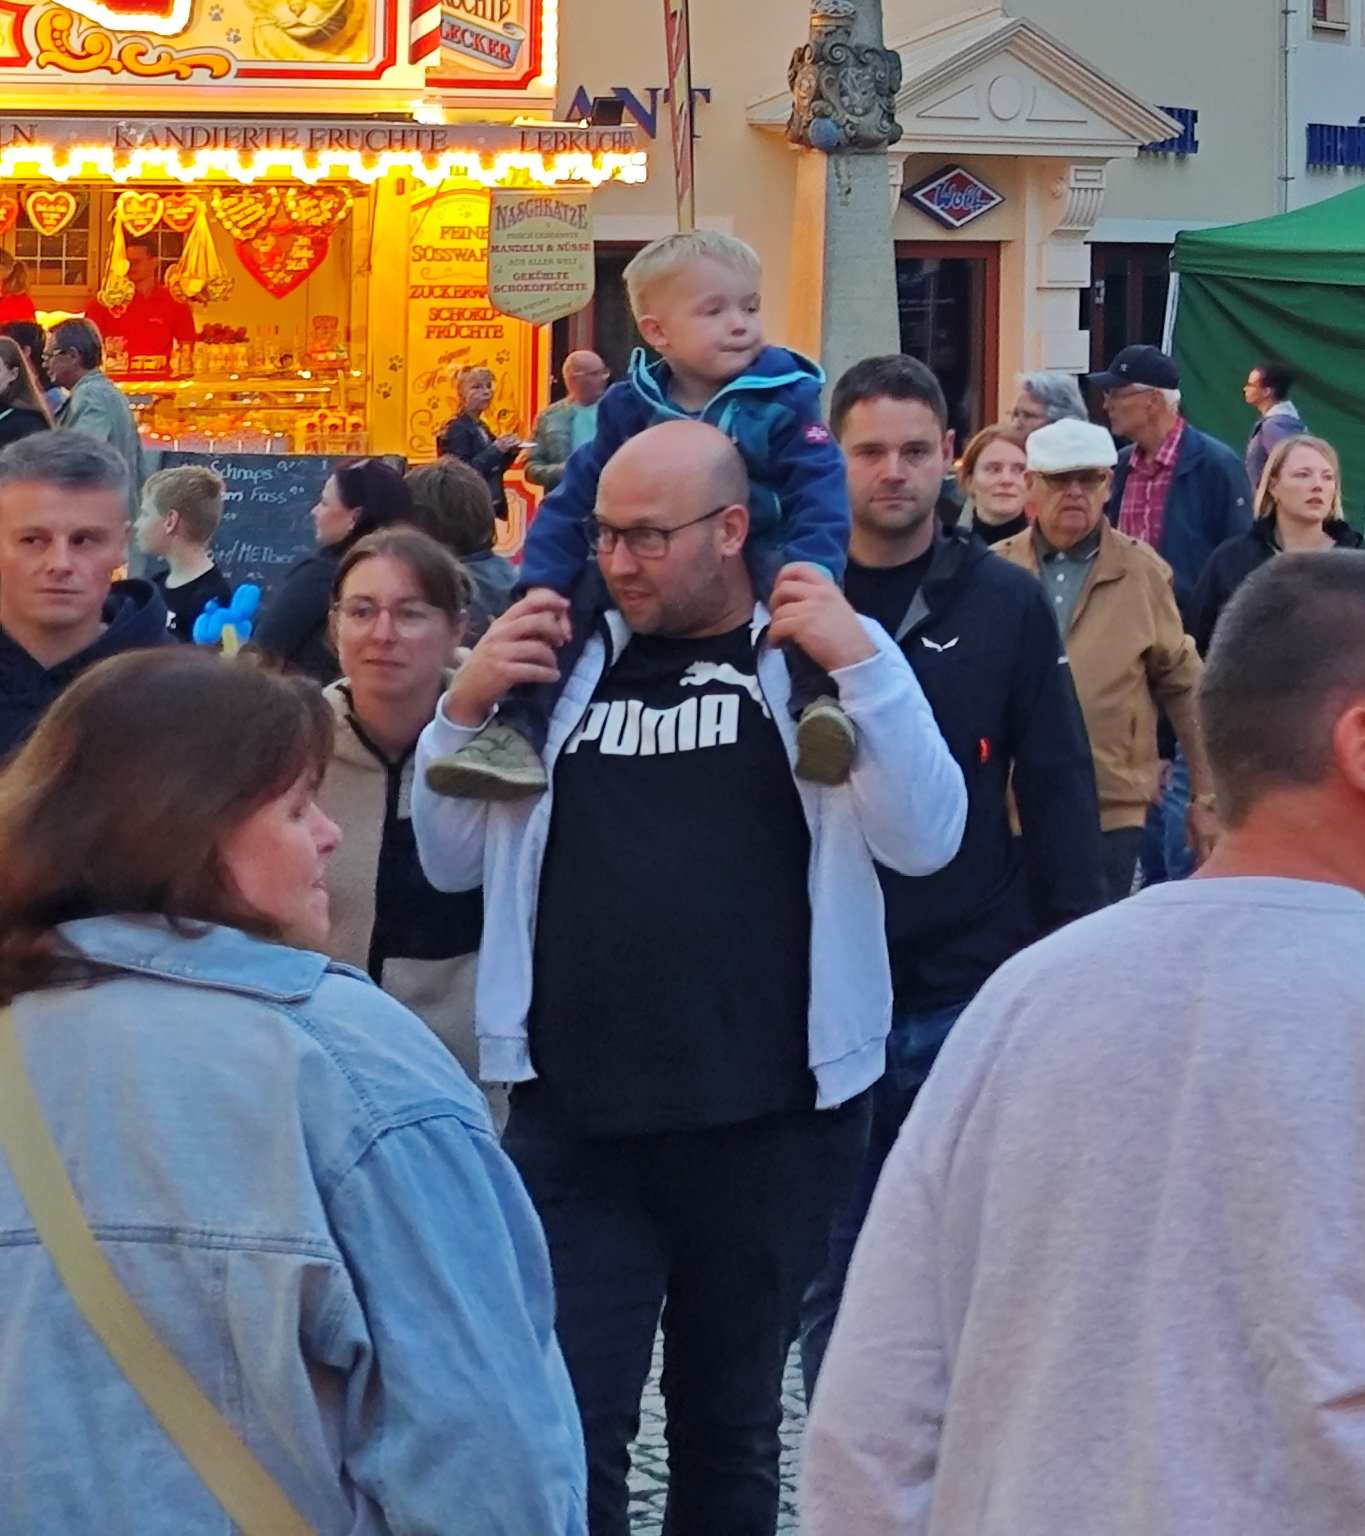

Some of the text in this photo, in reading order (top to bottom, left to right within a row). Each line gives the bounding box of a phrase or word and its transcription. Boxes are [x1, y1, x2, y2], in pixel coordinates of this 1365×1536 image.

[112, 124, 299, 150] KANDIERTE
[495, 198, 588, 231] NASCHKATZE
[491, 244, 543, 253] MANDELN
[210, 459, 273, 485] Schnaps
[249, 486, 288, 505] Fass
[564, 693, 740, 756] PUMA
